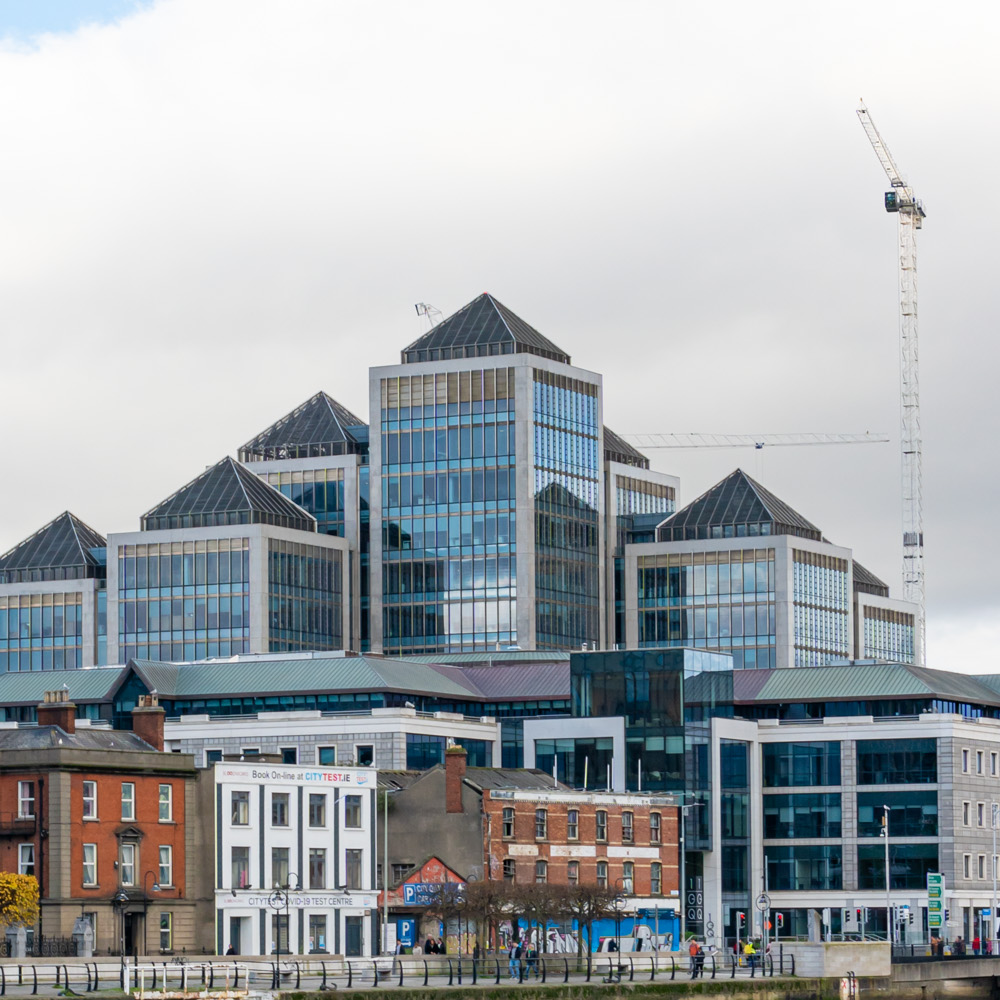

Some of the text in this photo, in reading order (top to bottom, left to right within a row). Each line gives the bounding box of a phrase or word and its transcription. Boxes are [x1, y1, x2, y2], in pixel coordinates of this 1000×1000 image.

[252, 770, 270, 779] Book
[271, 770, 296, 780] On-line
[297, 771, 304, 780] at
[305, 772, 351, 782] CITYTEST.IE
[406, 887, 414, 901] P
[312, 897, 328, 905] TEST
[329, 897, 353, 905] CENTRE
[402, 921, 410, 936] P
